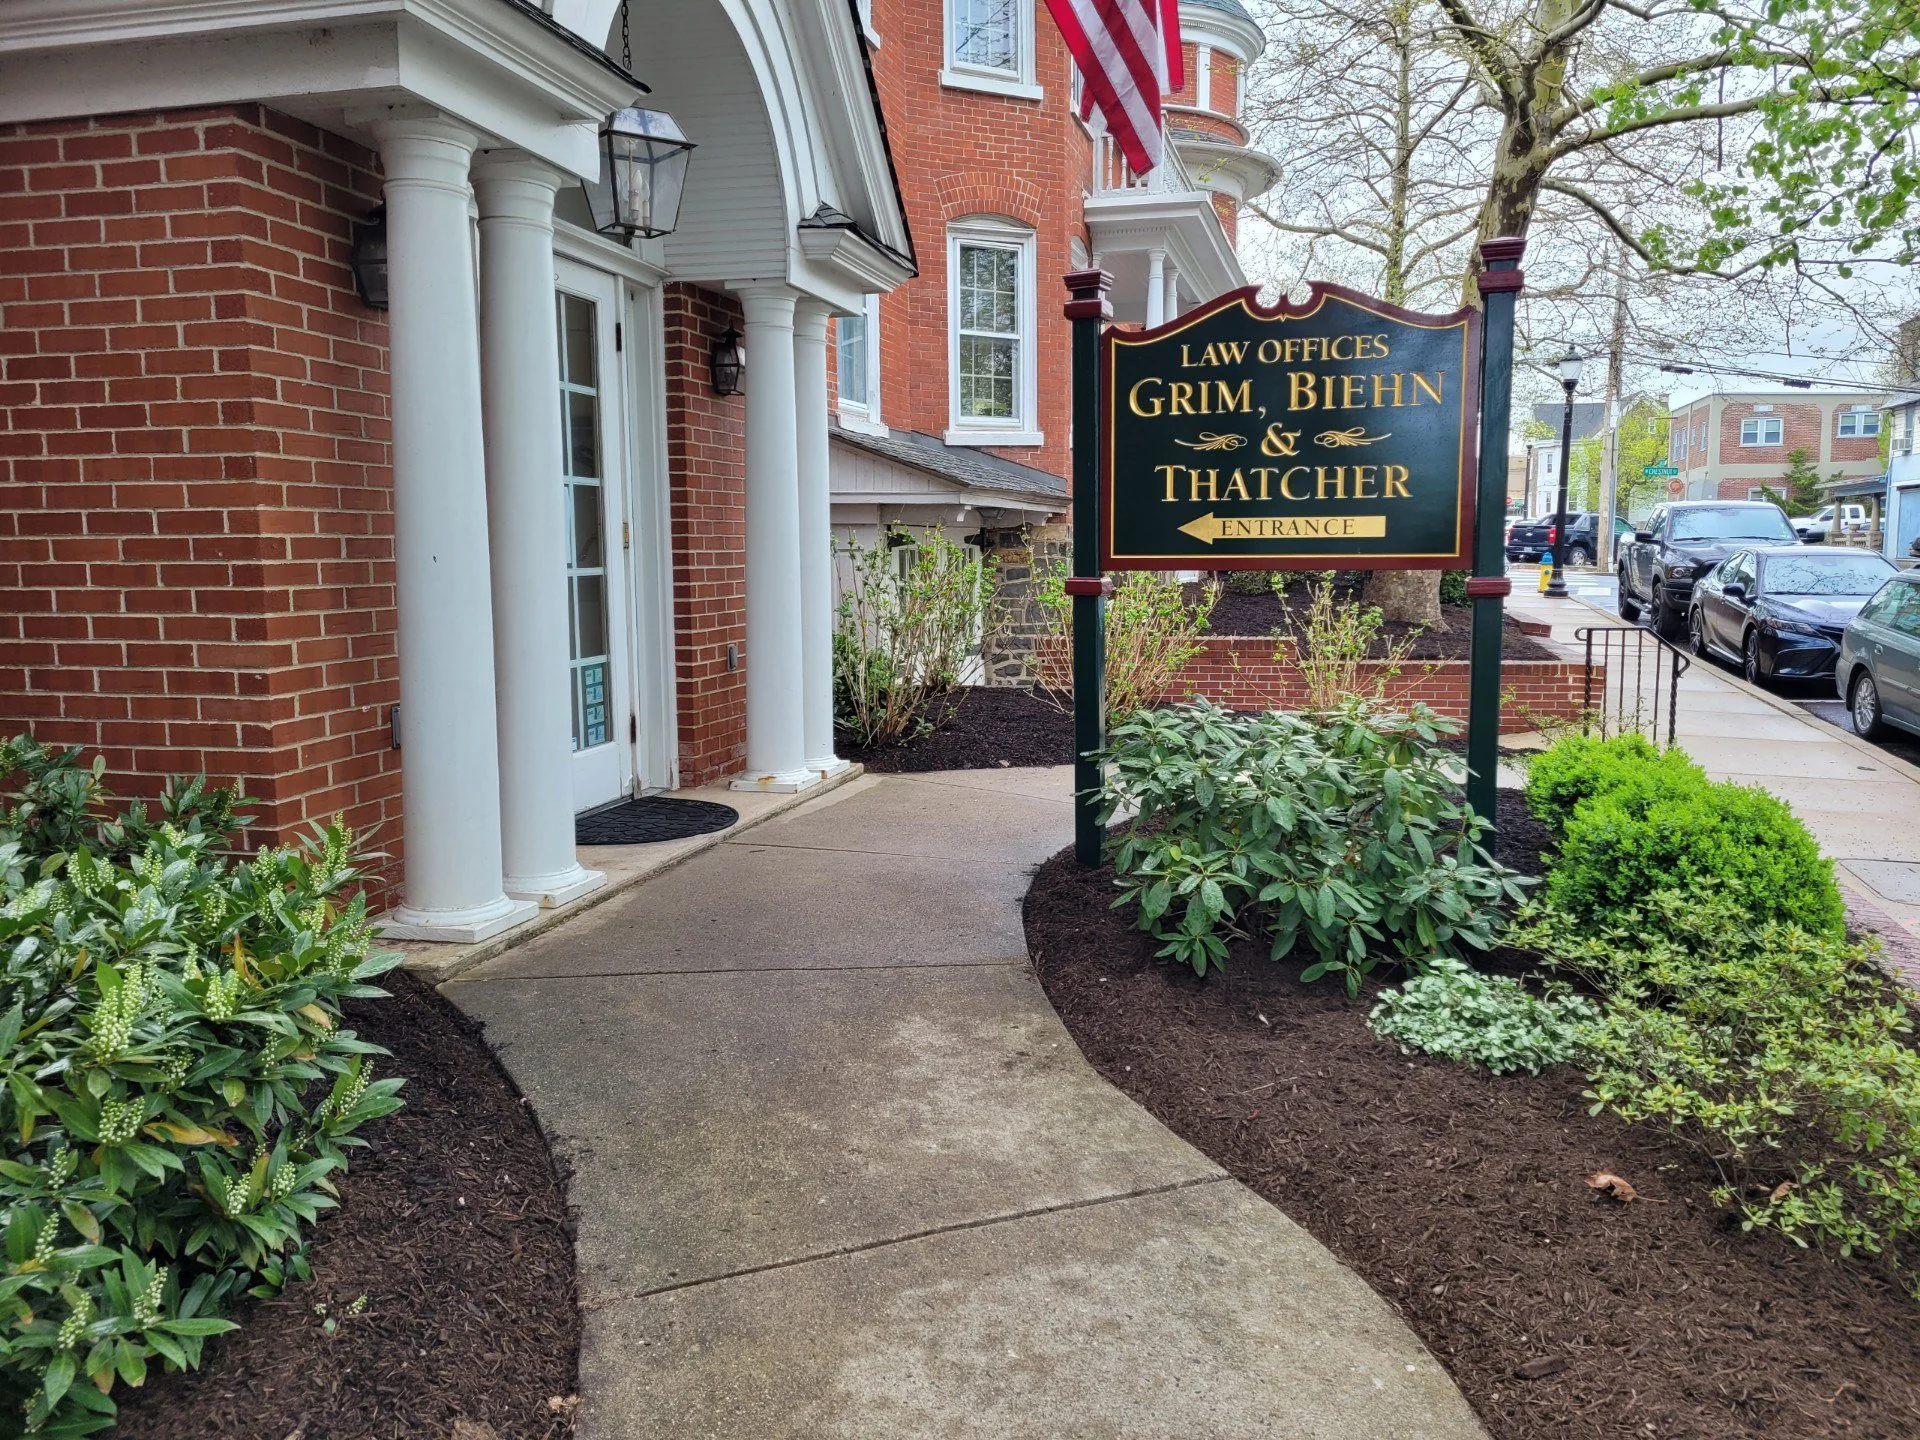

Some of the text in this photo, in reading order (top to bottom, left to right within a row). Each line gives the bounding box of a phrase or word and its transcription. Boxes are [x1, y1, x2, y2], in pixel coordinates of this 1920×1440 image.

[1181, 334, 1390, 367] LAW OFFICES
[1129, 370, 1445, 419] GRIM, BIEHN
[1261, 422, 1301, 456] &
[1154, 464, 1413, 502] THATCHER
[1221, 518, 1355, 536] ENTRANCE
